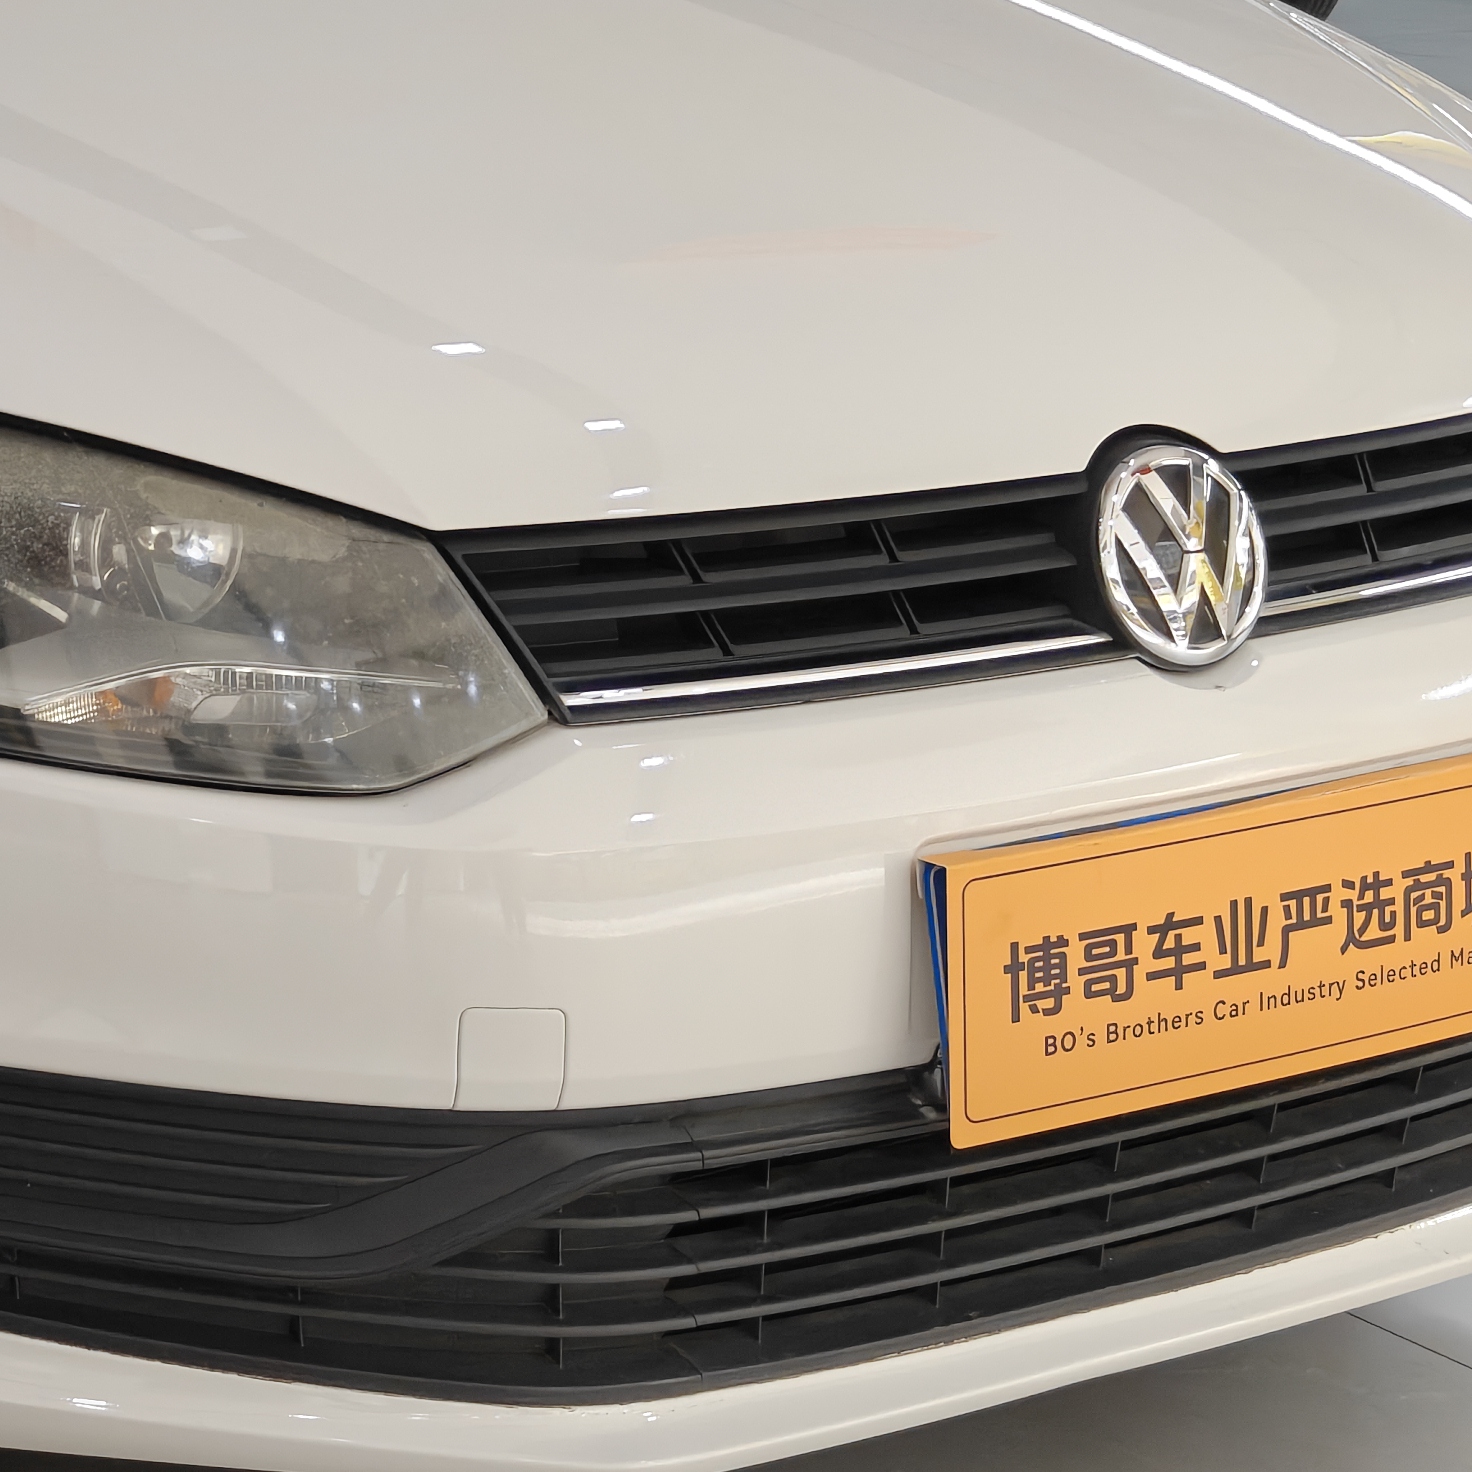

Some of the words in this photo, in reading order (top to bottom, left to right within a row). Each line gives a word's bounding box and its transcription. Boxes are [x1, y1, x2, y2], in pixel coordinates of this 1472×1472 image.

[1043, 1026, 1096, 1057] BO's
[1106, 1008, 1205, 1044] Brothers
[1213, 997, 1251, 1021] Car
[1258, 976, 1346, 1013] Industry
[1354, 958, 1442, 992] Selected
